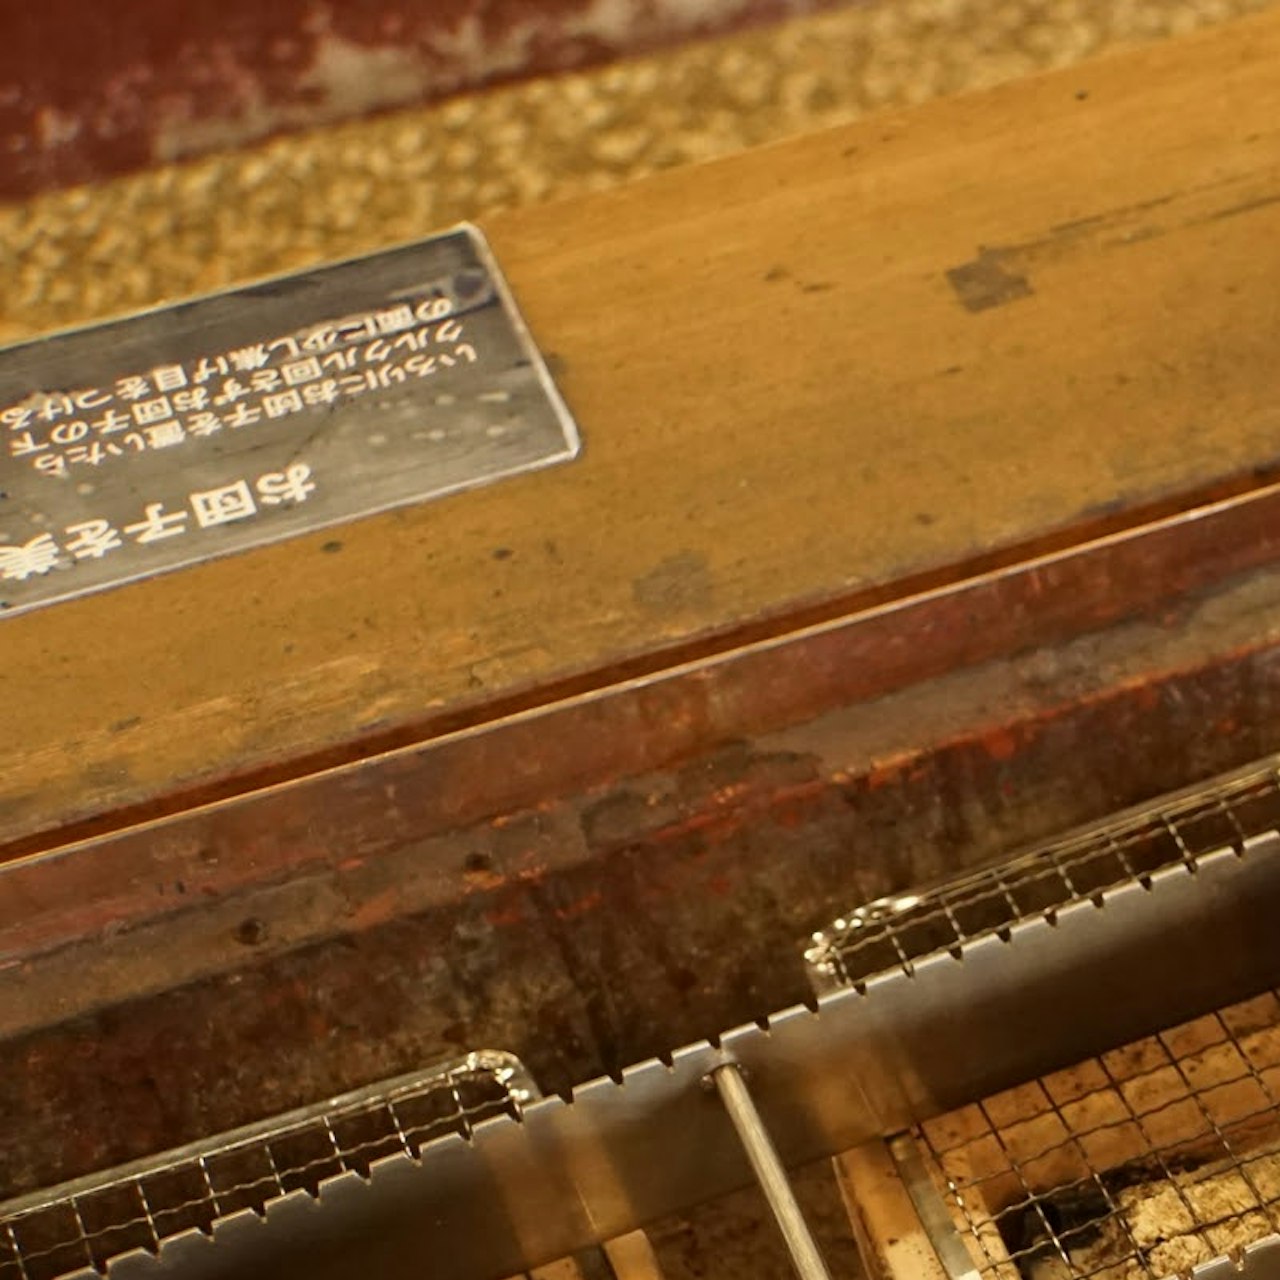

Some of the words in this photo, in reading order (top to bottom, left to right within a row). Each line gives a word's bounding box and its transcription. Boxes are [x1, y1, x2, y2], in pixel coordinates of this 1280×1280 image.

[0, 296, 455, 431] の面に少し焦げ目をつける
[8, 317, 465, 458] クルクル回さずお団子の下
[32, 341, 478, 479] いろりにお団子を置いたら
[0, 462, 316, 580] お団子を美
